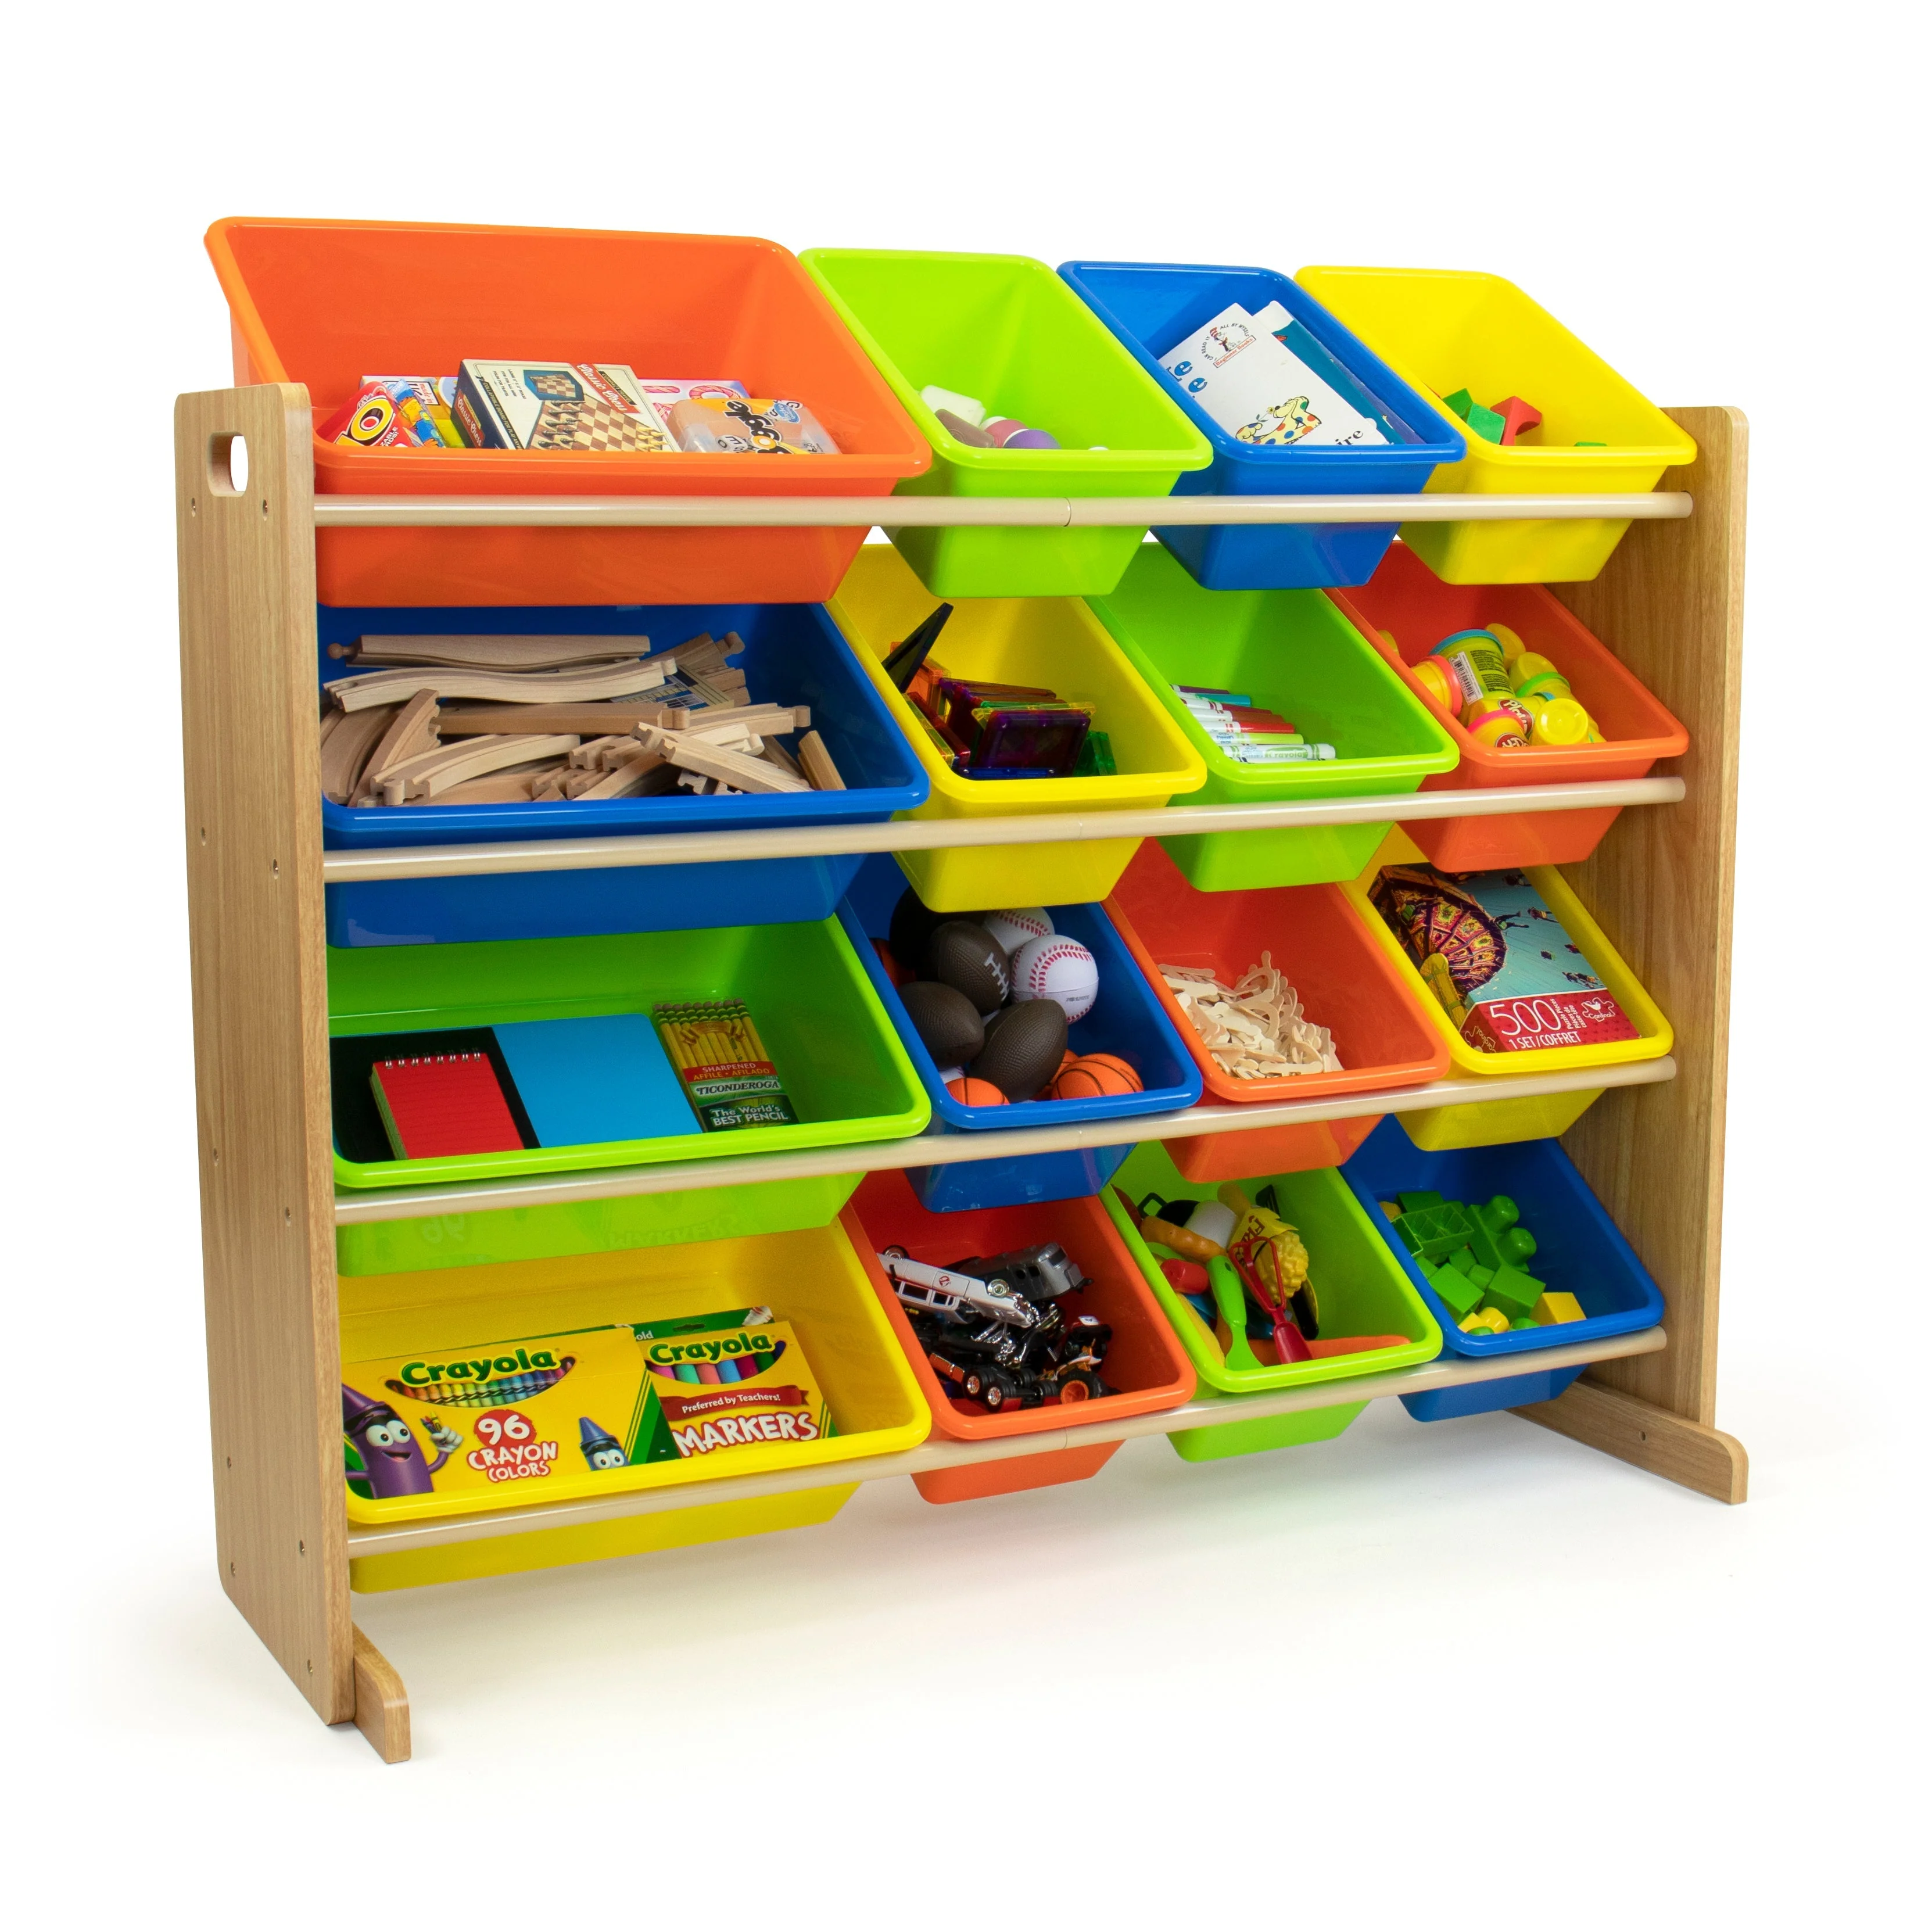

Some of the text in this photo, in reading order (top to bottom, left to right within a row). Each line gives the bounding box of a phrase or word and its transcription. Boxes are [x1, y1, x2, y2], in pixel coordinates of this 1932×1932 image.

[1239, 324, 1249, 337] MYSELF
[1216, 338, 1253, 365] Beginner Books
[576, 364, 607, 390] Classic
[602, 390, 628, 411] Chess
[1490, 999, 1561, 1035] 500
[693, 1068, 770, 1081] AFFILE AFILADO
[702, 1062, 756, 1073] SHARPENED
[696, 1081, 780, 1095] TICONDEROGA
[711, 1104, 781, 1117] The World's
[711, 1112, 788, 1126] BEST PENCIL
[636, 1330, 654, 1340] old
[650, 1333, 773, 1363] Crayola
[402, 1348, 557, 1385] Crayola
[682, 1393, 781, 1414] Preferred by Teachers!
[478, 1414, 530, 1445] 96
[672, 1413, 818, 1456] MARKERS
[468, 1442, 558, 1470] CRAYON
[488, 1461, 550, 1482] COLORS
